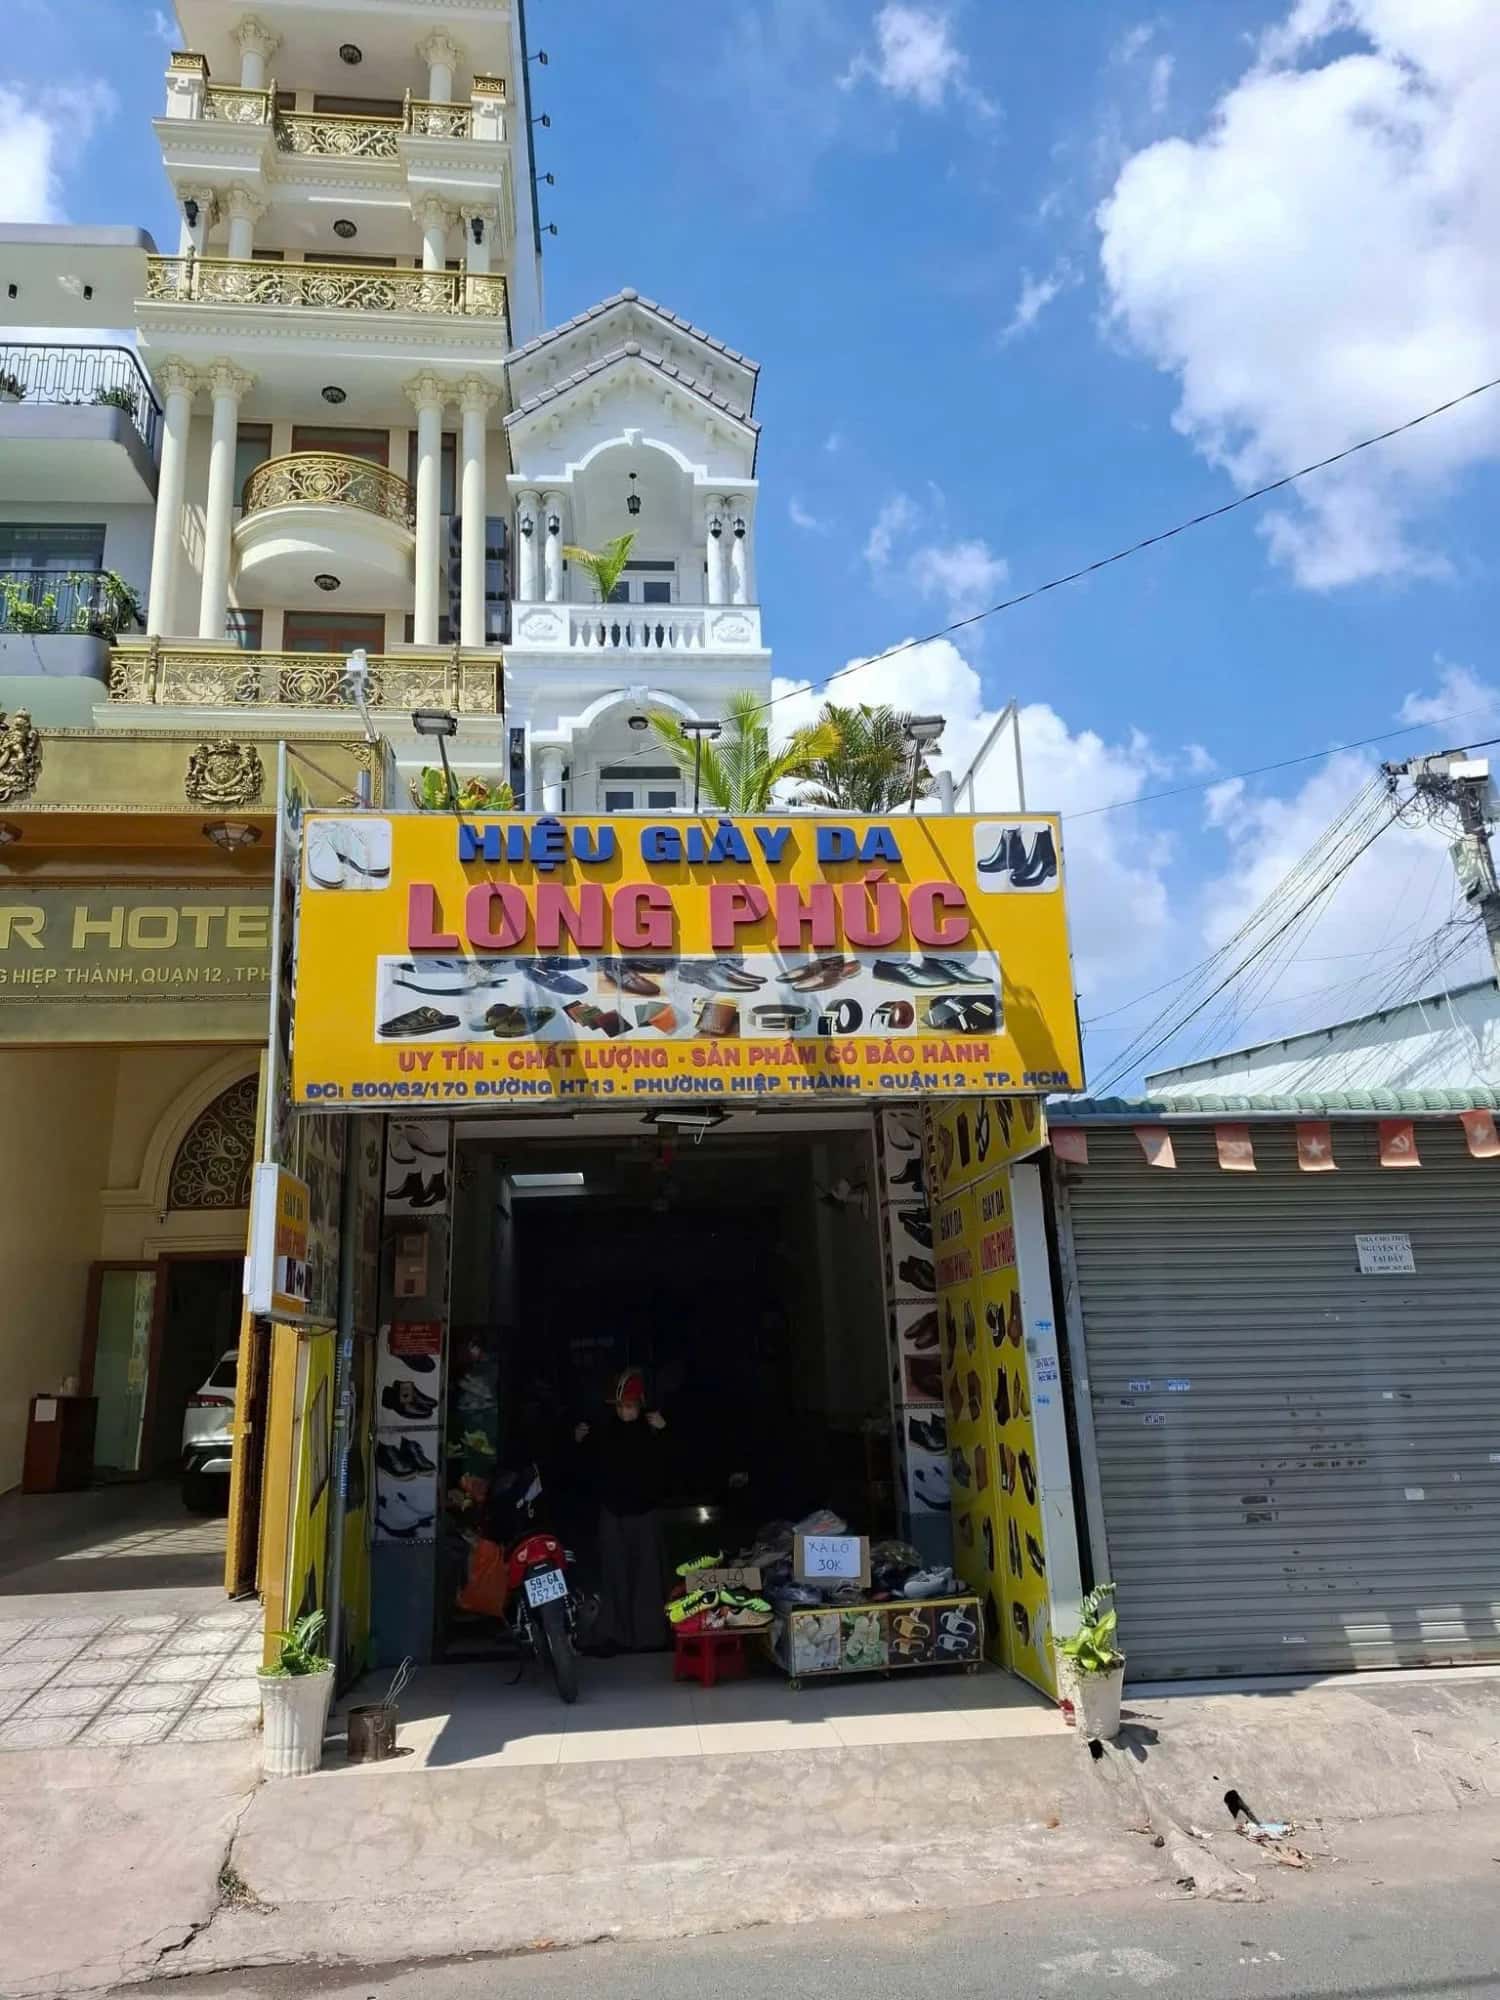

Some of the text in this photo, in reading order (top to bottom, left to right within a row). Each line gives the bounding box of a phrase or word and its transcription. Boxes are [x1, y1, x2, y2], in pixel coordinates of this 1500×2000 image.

[459, 817, 902, 871] HIỆU GIÀY DA
[72, 905, 272, 949] HOTE
[408, 869, 971, 950] LONG PHÚC
[398, 1050, 434, 1072] UY
[441, 1043, 484, 1071] TÍN
[584, 1044, 669, 1074] LƯỢNG
[691, 1041, 741, 1067] SẢN
[748, 1037, 817, 1066] PHẨM
[824, 1041, 858, 1065] CÓ
[865, 1038, 915, 1064] BẢO
[922, 1041, 990, 1063] HÀNH
[351, 1079, 468, 1098] 500/62/170
[474, 1076, 552, 1095] ĐƯỜNG
[559, 1078, 615, 1094] HT13
[633, 1074, 723, 1094] PHƯỜNG
[731, 1073, 781, 1095] HIỆP
[788, 1072, 861, 1091] THÀNH
[983, 1072, 1017, 1087] TP.
[1023, 1071, 1069, 1086] HCM
[817, 1559, 843, 1571] 30K
